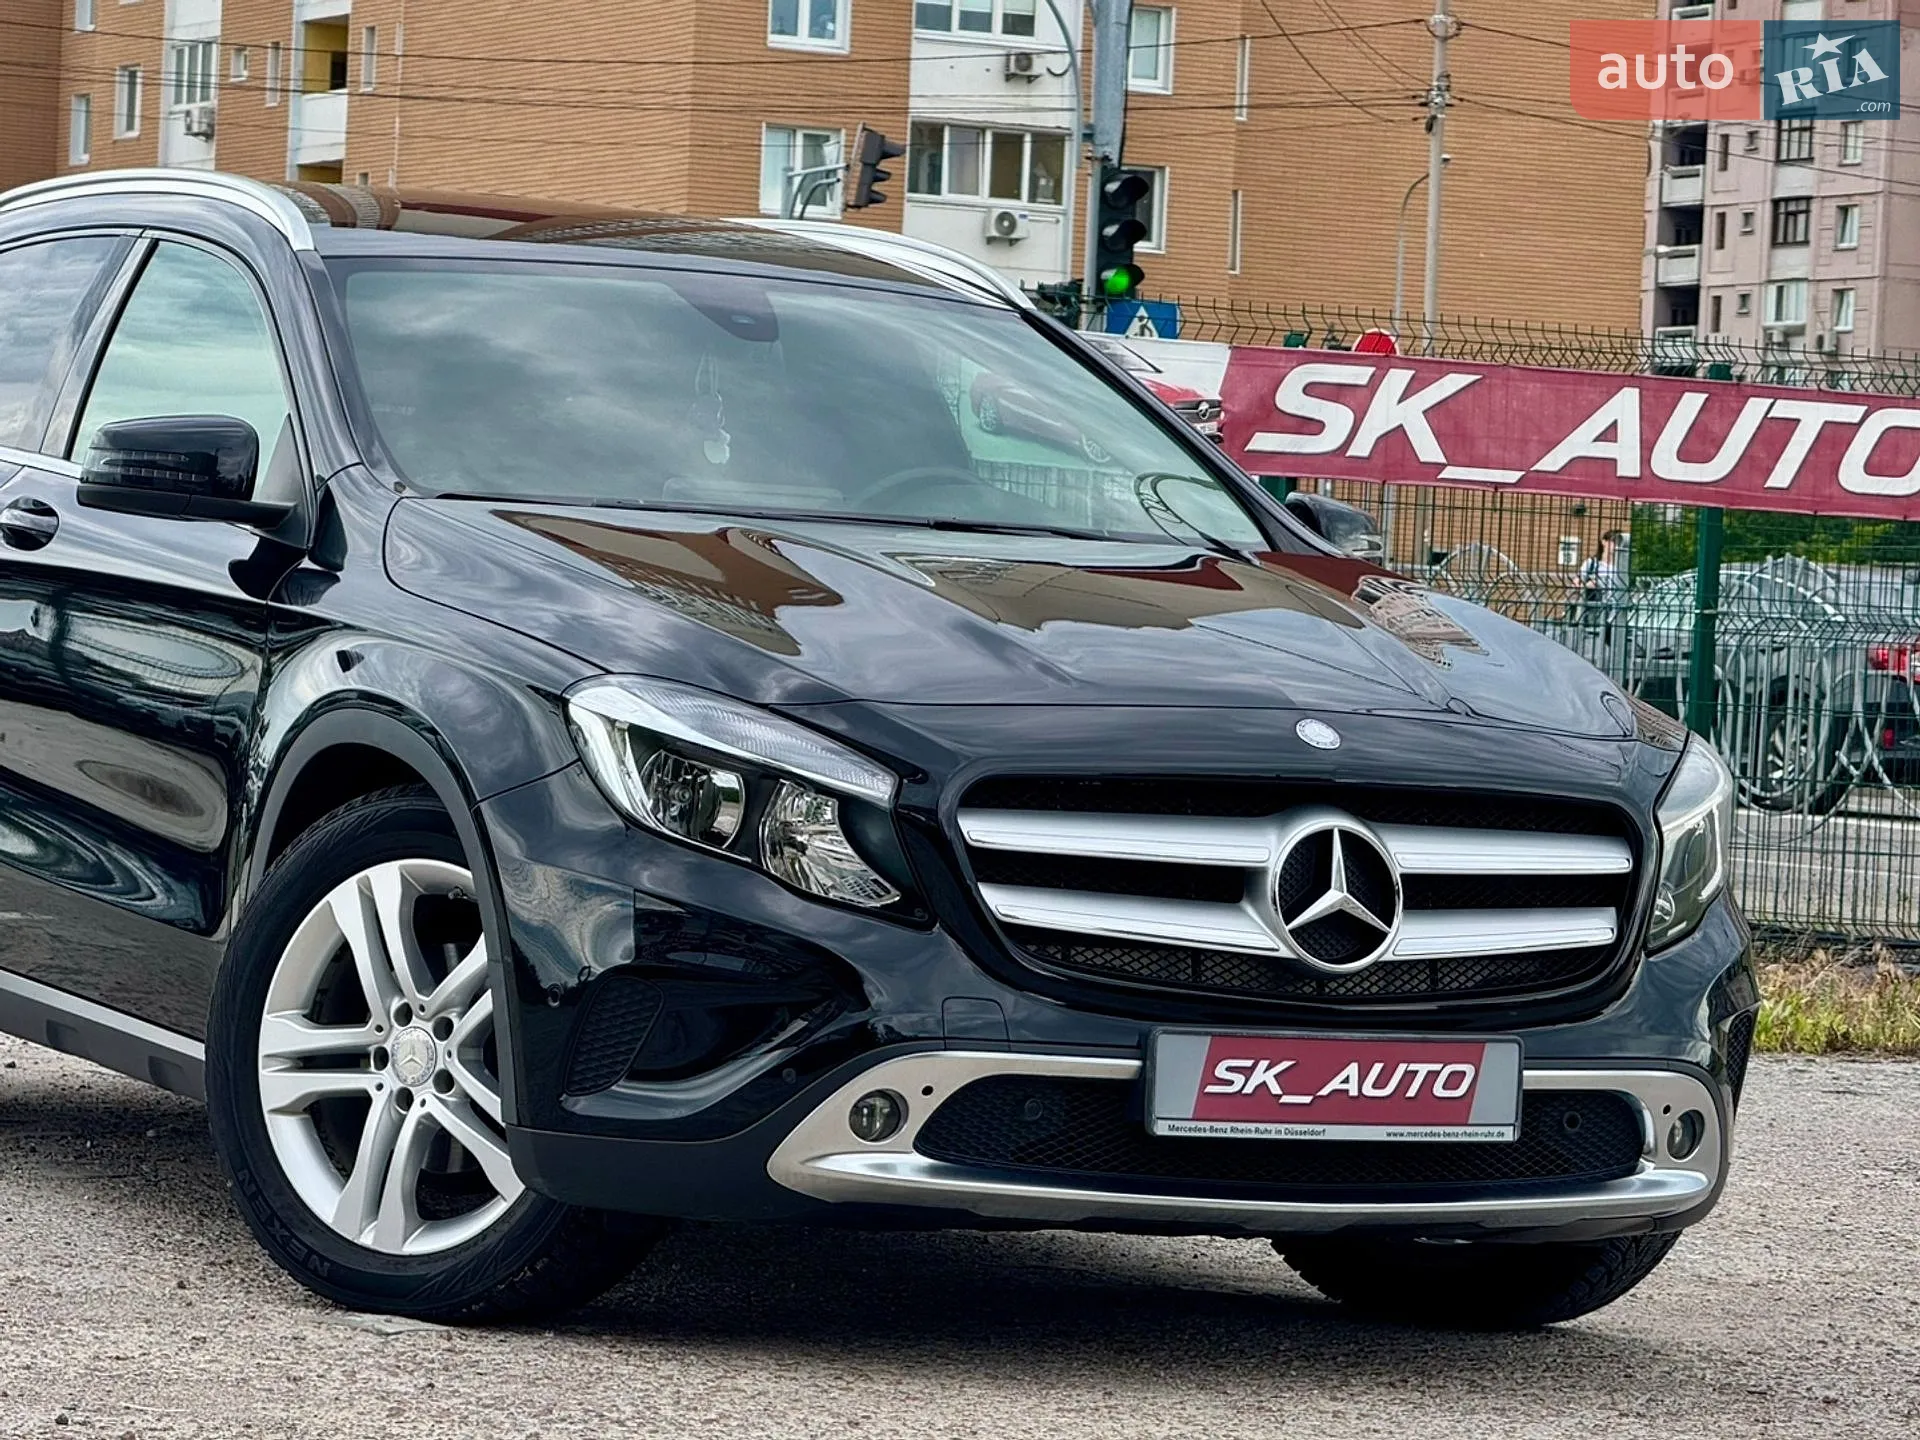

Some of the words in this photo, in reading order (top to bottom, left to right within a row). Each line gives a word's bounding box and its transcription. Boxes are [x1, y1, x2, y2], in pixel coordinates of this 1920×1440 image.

[1245, 364, 1920, 496] SK_AUTO
[1203, 1059, 1476, 1105] SK_AUTO
[1167, 1124, 1228, 1134] Mercedes-Benz
[1274, 1126, 1282, 1135] in
[1284, 1125, 1326, 1137] Düsseldorf
[236, 1168, 331, 1277] NEXEN
